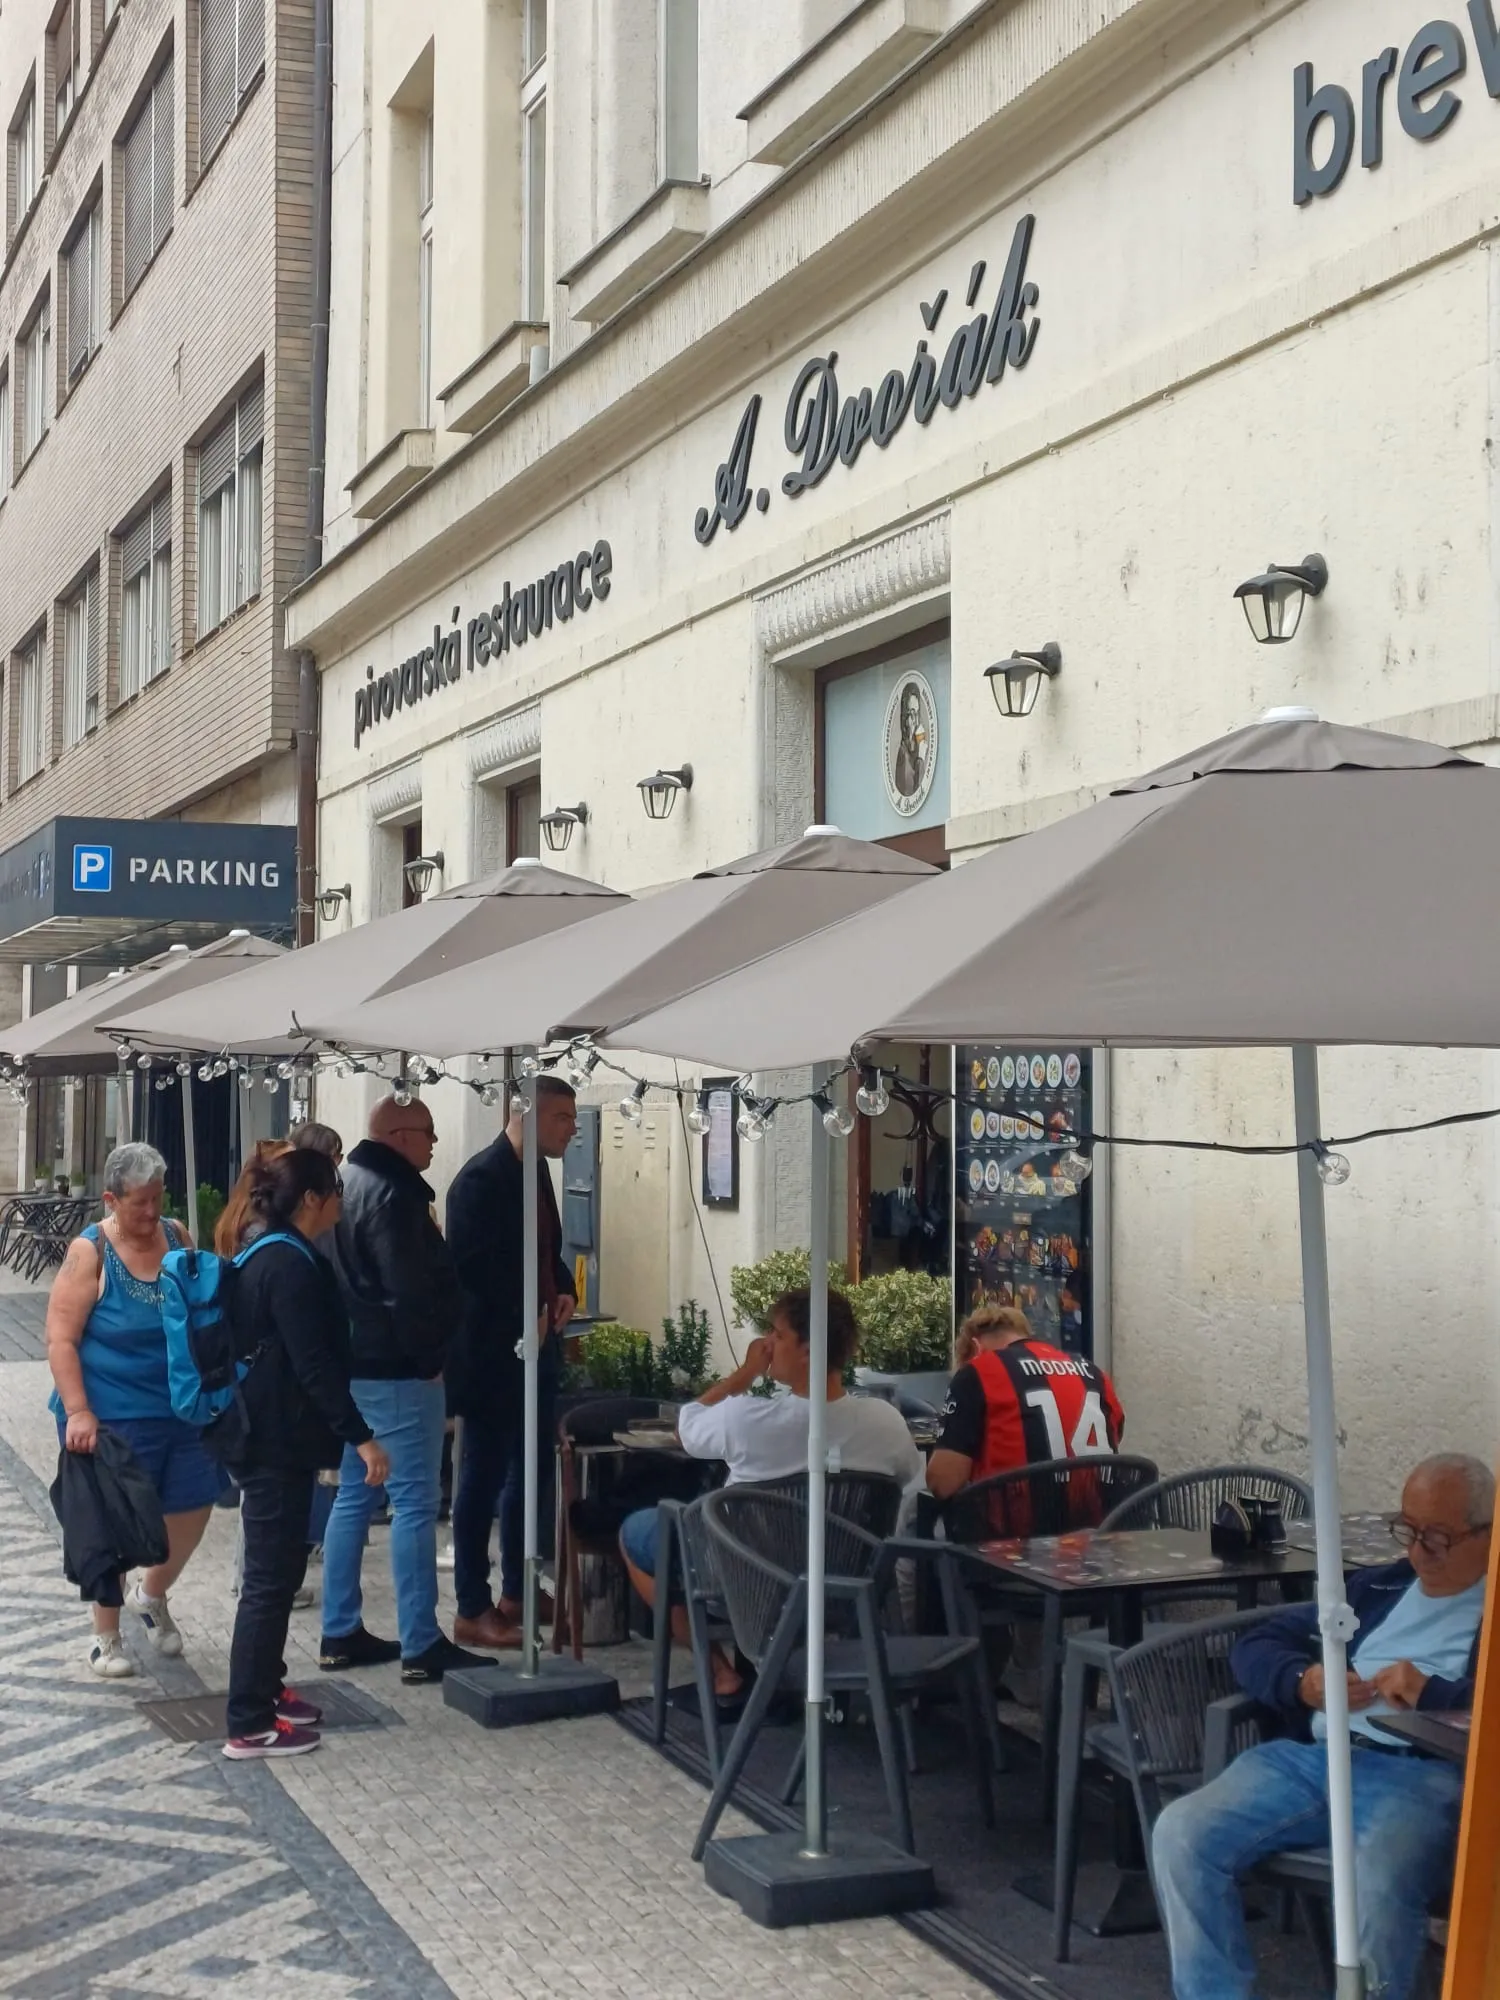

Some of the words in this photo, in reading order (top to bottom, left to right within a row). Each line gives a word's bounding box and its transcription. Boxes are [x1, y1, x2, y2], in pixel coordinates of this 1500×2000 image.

[694, 393, 770, 544] A.
[781, 213, 1041, 496] Dvořák
[354, 605, 462, 750] pivovarská
[466, 539, 613, 673] restaurace
[79, 852, 105, 883] P
[129, 857, 279, 888] PARKING
[1025, 1389, 1115, 1460] 14
